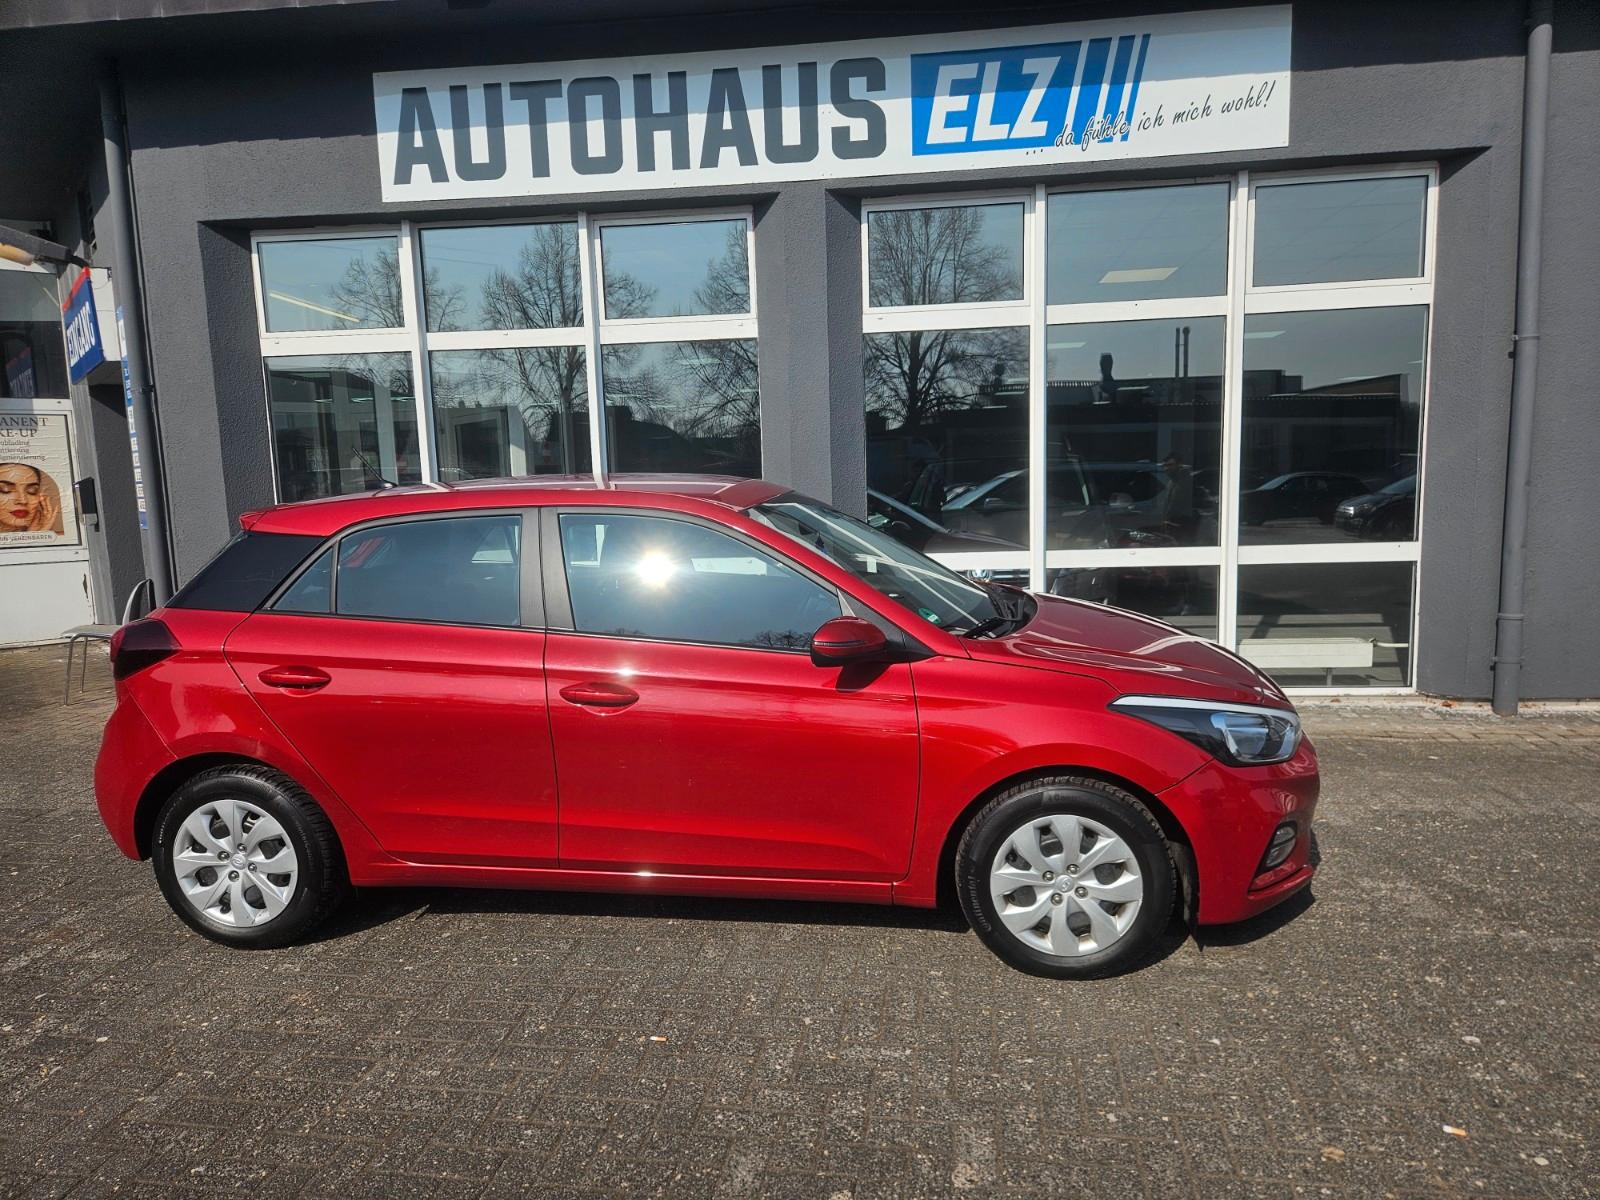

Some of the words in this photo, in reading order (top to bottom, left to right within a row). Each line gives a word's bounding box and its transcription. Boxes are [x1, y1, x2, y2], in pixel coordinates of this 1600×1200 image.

[393, 56, 887, 186] AUTOHAUS
[926, 56, 1062, 145] ELZ
[1055, 123, 1074, 147] da
[1081, 111, 1129, 151] fühle
[1137, 104, 1164, 131] ich
[1172, 94, 1212, 124] mich
[1221, 79, 1276, 111] wohl!
[66, 301, 96, 368] EINGANG
